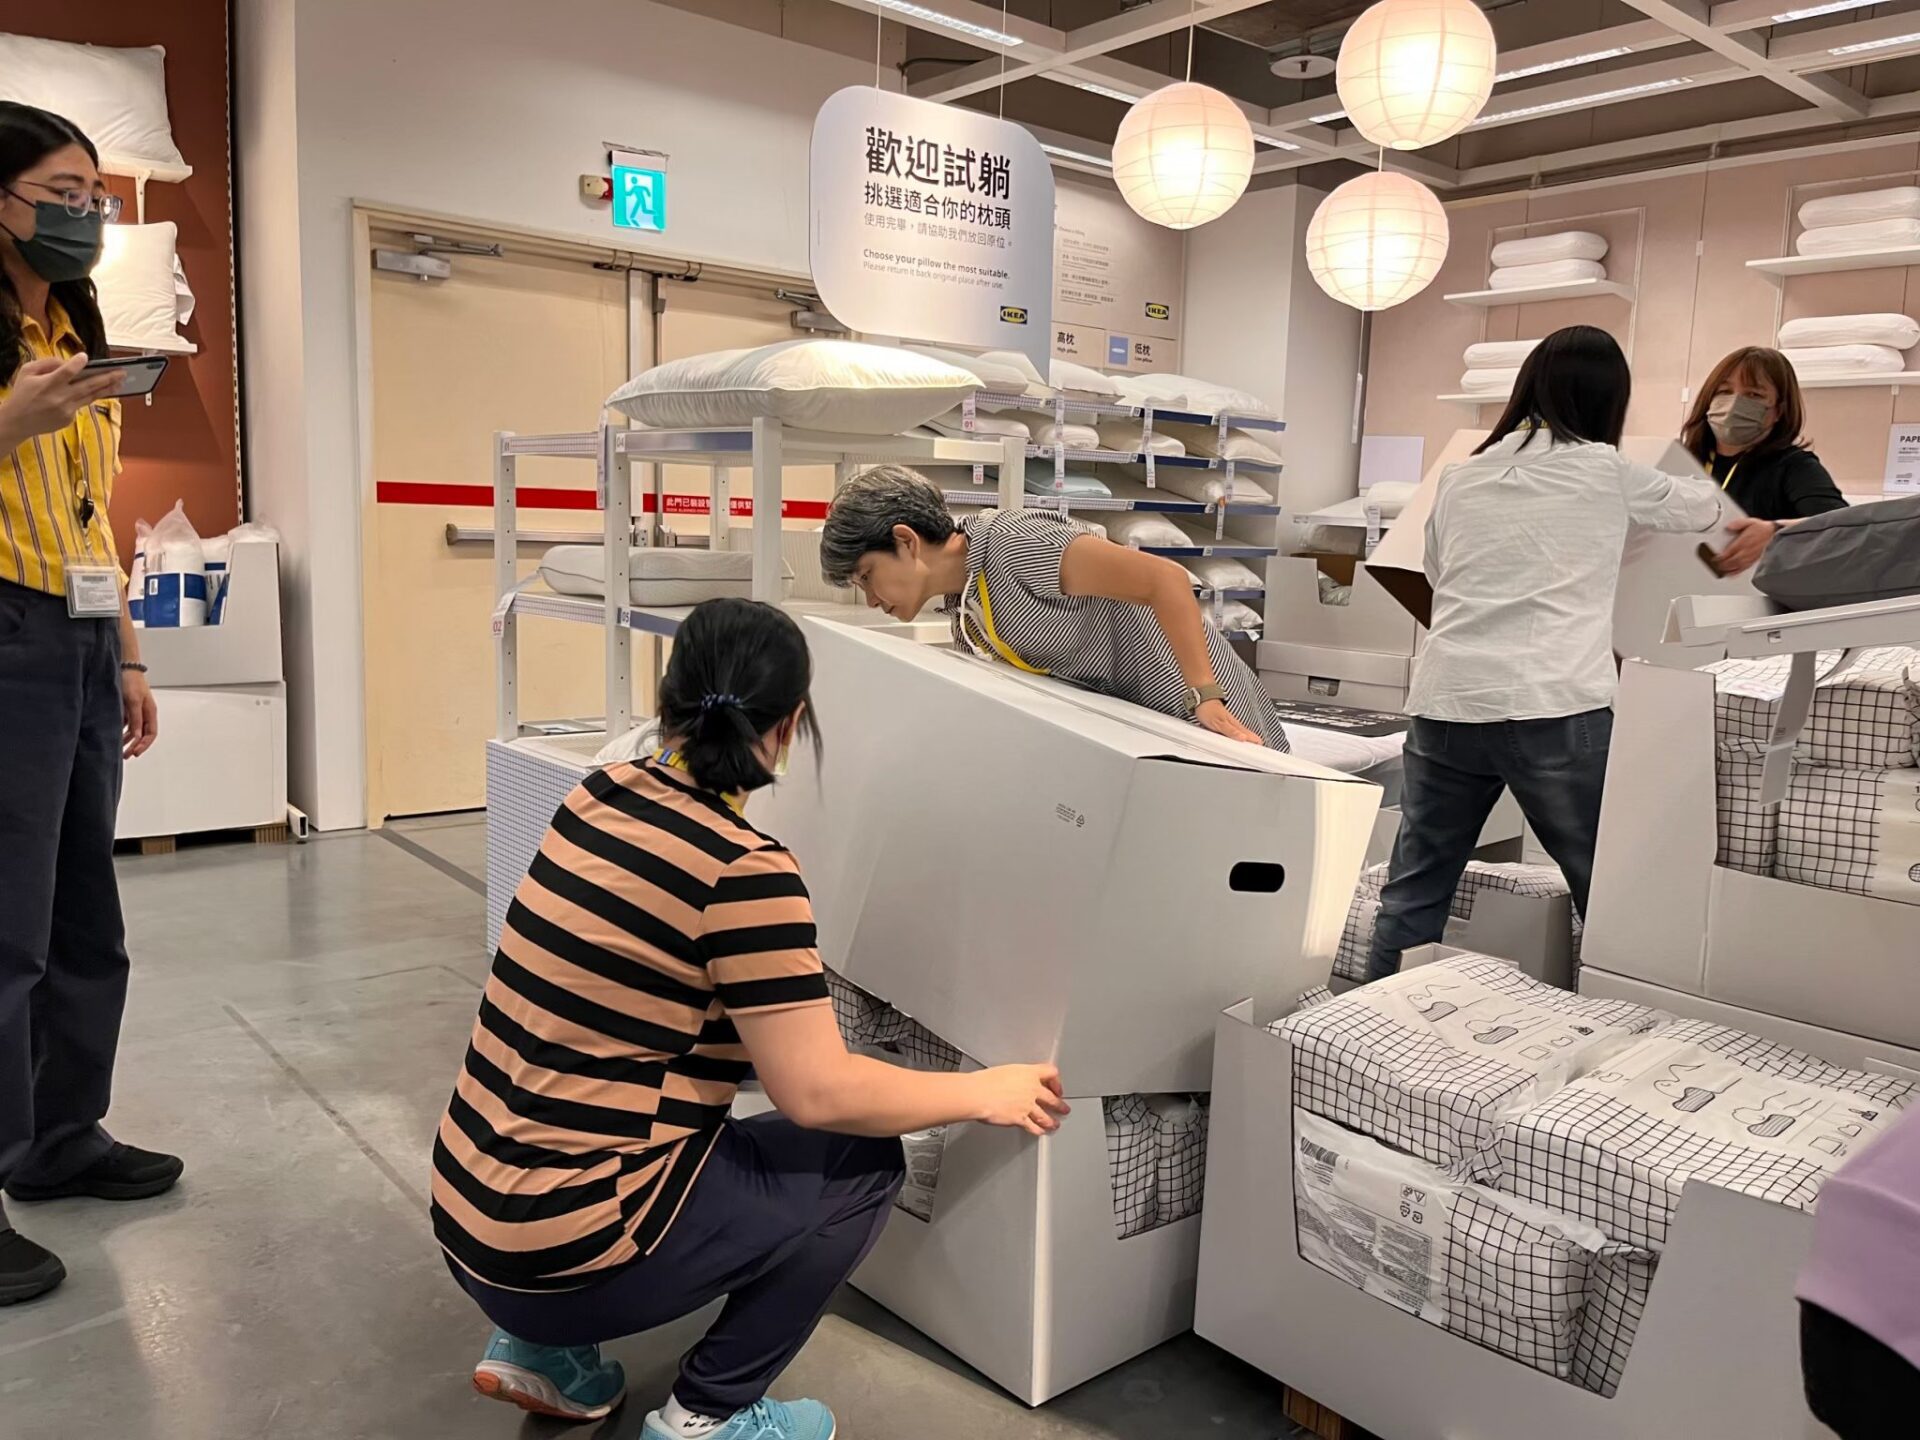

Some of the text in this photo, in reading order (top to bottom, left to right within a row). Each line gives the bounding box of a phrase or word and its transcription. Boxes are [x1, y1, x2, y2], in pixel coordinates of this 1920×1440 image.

[865, 126, 1011, 200] 歡迎試躺
[864, 180, 1011, 231] 挑選適合你的枕頭
[863, 248, 1010, 281] Choose your pillow the most suitable.
[863, 260, 886, 272] Please
[887, 265, 909, 275] return
[916, 269, 931, 278] back
[932, 272, 957, 282] original
[976, 279, 990, 287] after
[1002, 309, 1026, 321] IKEA
[1147, 306, 1168, 317] IKEA
[1057, 331, 1075, 346] 高枕
[1134, 342, 1151, 357] 低枕
[964, 420, 973, 428] 01
[974, 473, 982, 481] 02
[492, 621, 503, 633] 02
